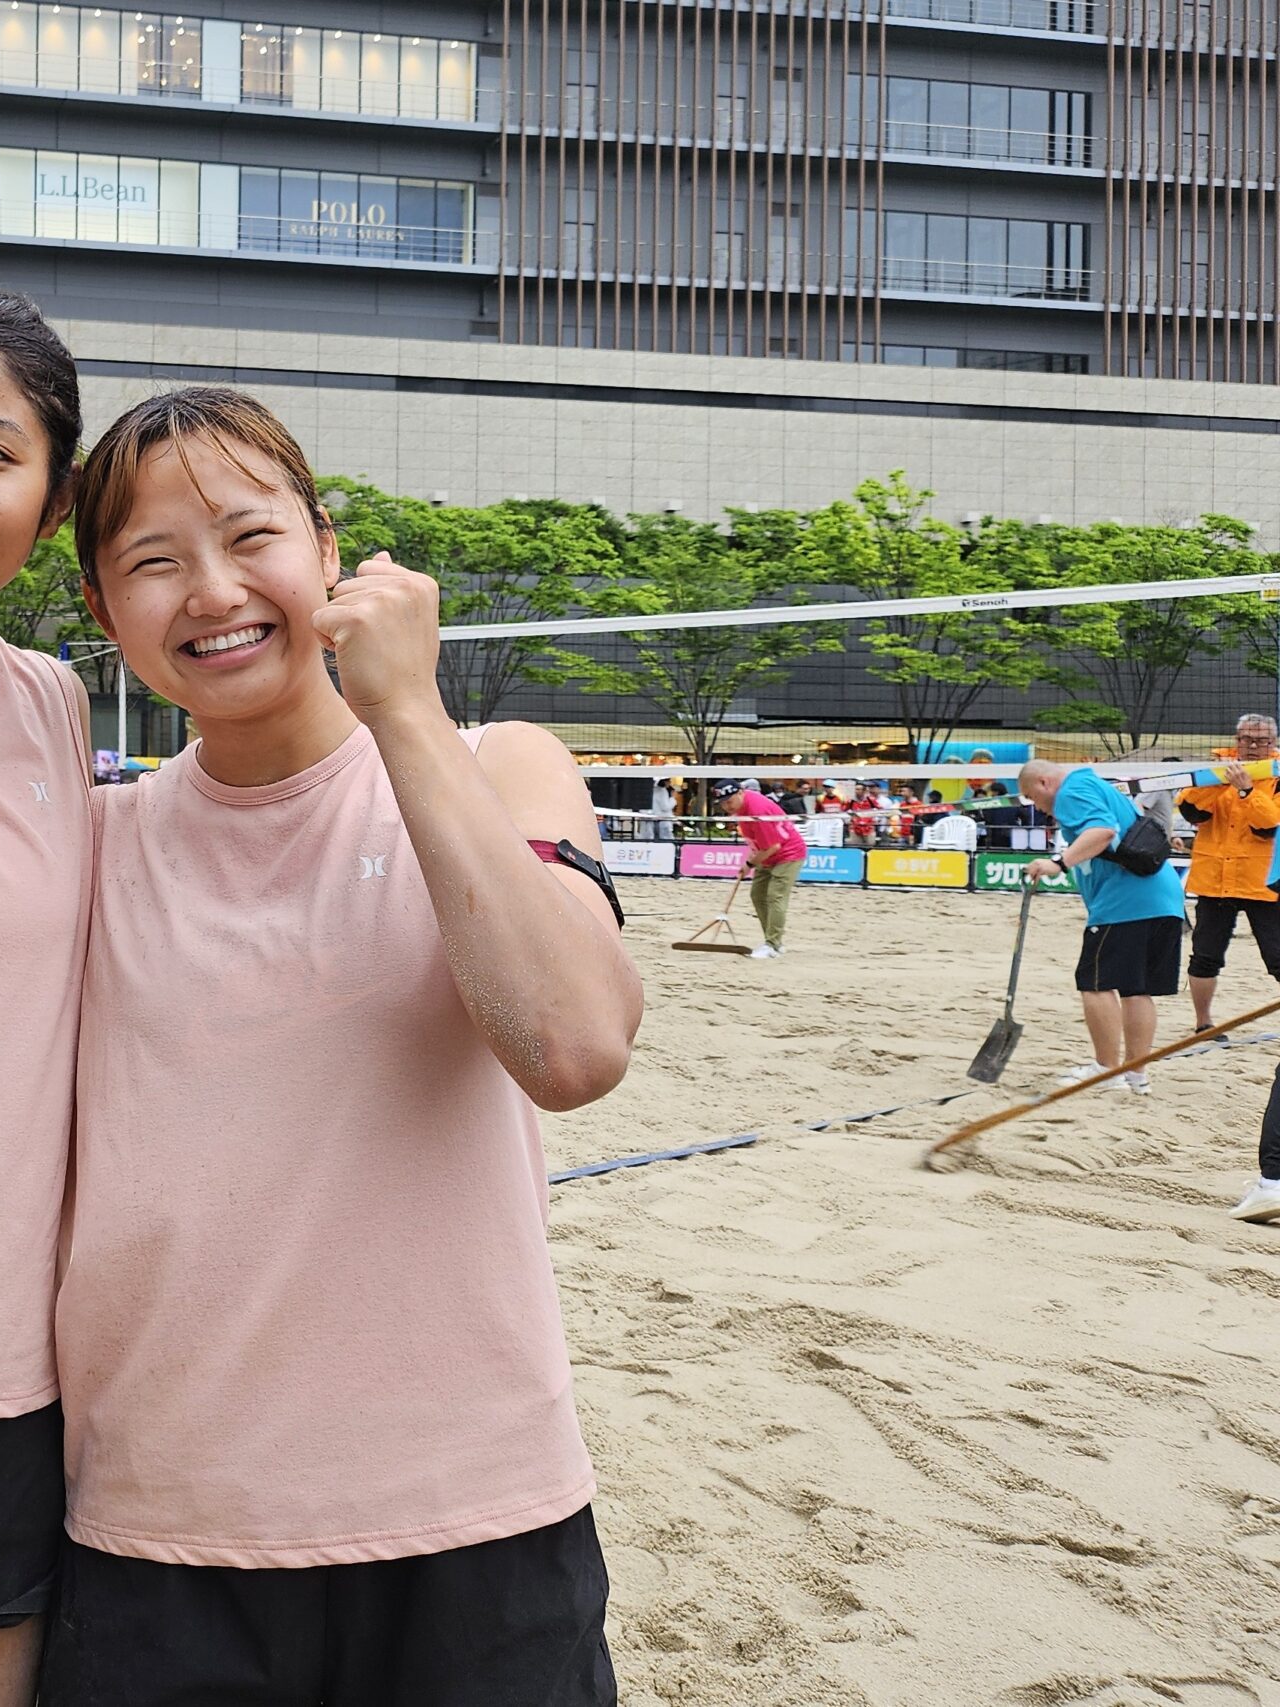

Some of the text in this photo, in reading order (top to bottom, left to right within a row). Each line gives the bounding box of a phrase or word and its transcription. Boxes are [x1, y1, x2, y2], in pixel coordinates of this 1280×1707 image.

[39, 173, 146, 203] L.L.Bean
[311, 200, 385, 226] POLO
[289, 224, 338, 237] RALPH
[716, 852, 743, 865] BVT
[808, 855, 837, 868] BVT
